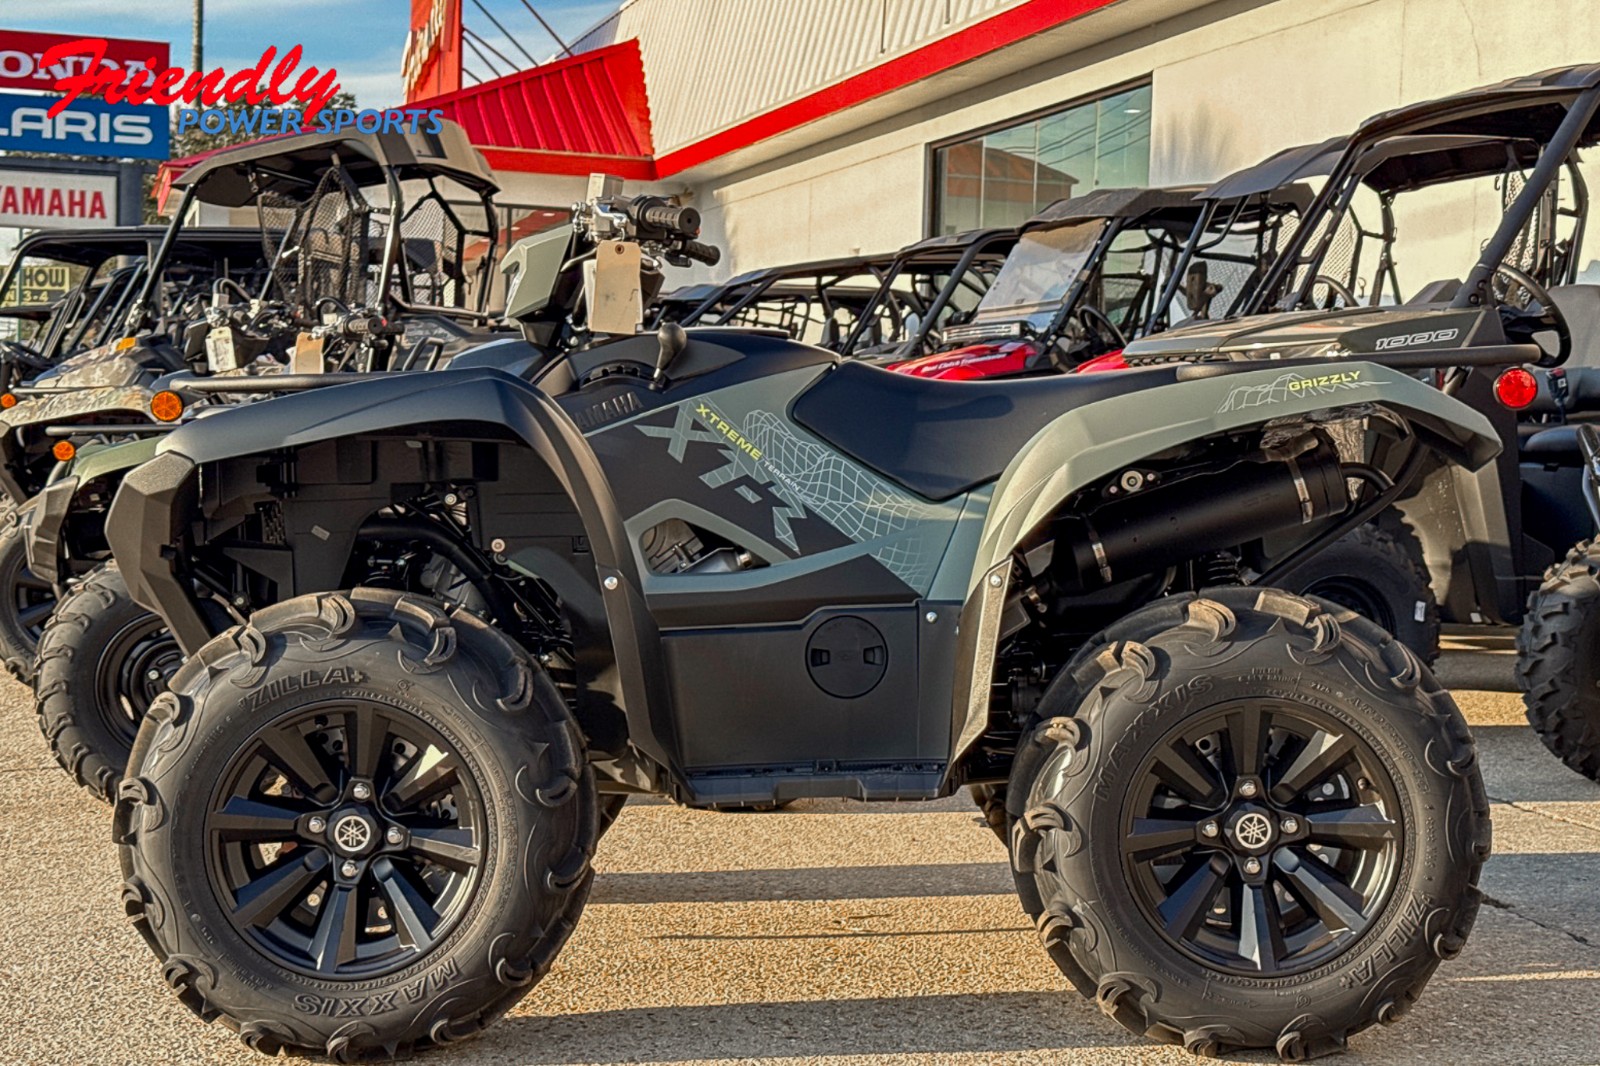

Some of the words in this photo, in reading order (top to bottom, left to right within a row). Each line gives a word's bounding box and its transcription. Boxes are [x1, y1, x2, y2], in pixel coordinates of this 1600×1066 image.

[0, 107, 153, 145] ARIS
[0, 186, 107, 219] AMAHA
[22, 268, 66, 287] HOW
[1375, 328, 1459, 350] 1000
[1288, 371, 1361, 391] GRIZZLY
[574, 391, 644, 428] AMAHA
[696, 403, 762, 460] XTREME
[763, 460, 801, 491] TERRAIN
[292, 957, 461, 1017] MAXXIS
